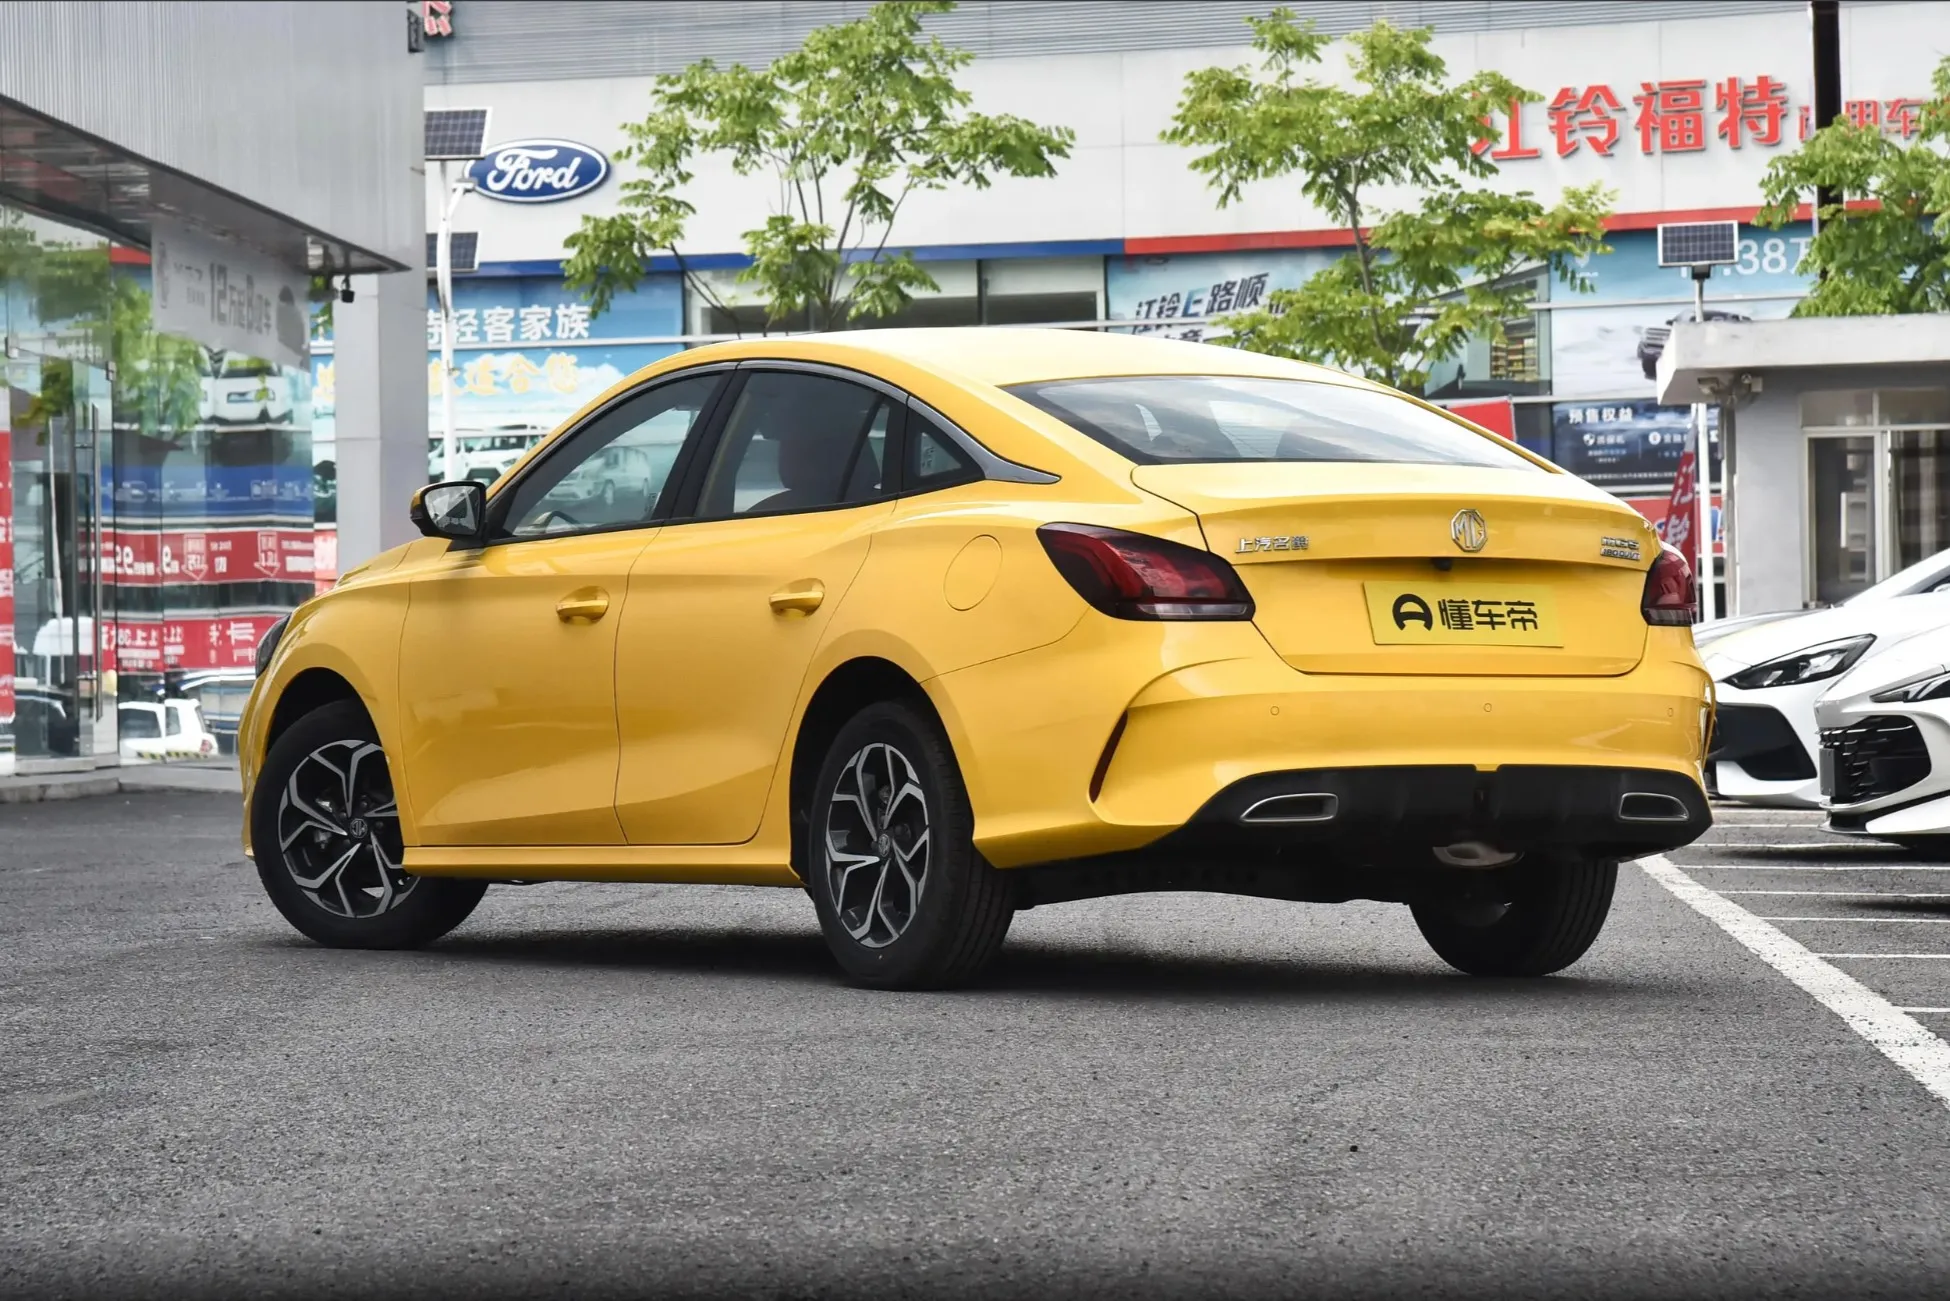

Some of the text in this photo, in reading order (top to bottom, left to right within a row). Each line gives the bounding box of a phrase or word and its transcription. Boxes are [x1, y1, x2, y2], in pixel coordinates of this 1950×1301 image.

[1468, 75, 1788, 160] 江铃福特
[486, 147, 583, 192] Ford
[1569, 407, 1633, 424] 预售权益
[1235, 535, 1309, 554] 上汽名爵
[1451, 508, 1487, 553] MG
[1437, 598, 1539, 632] 懂车帝
